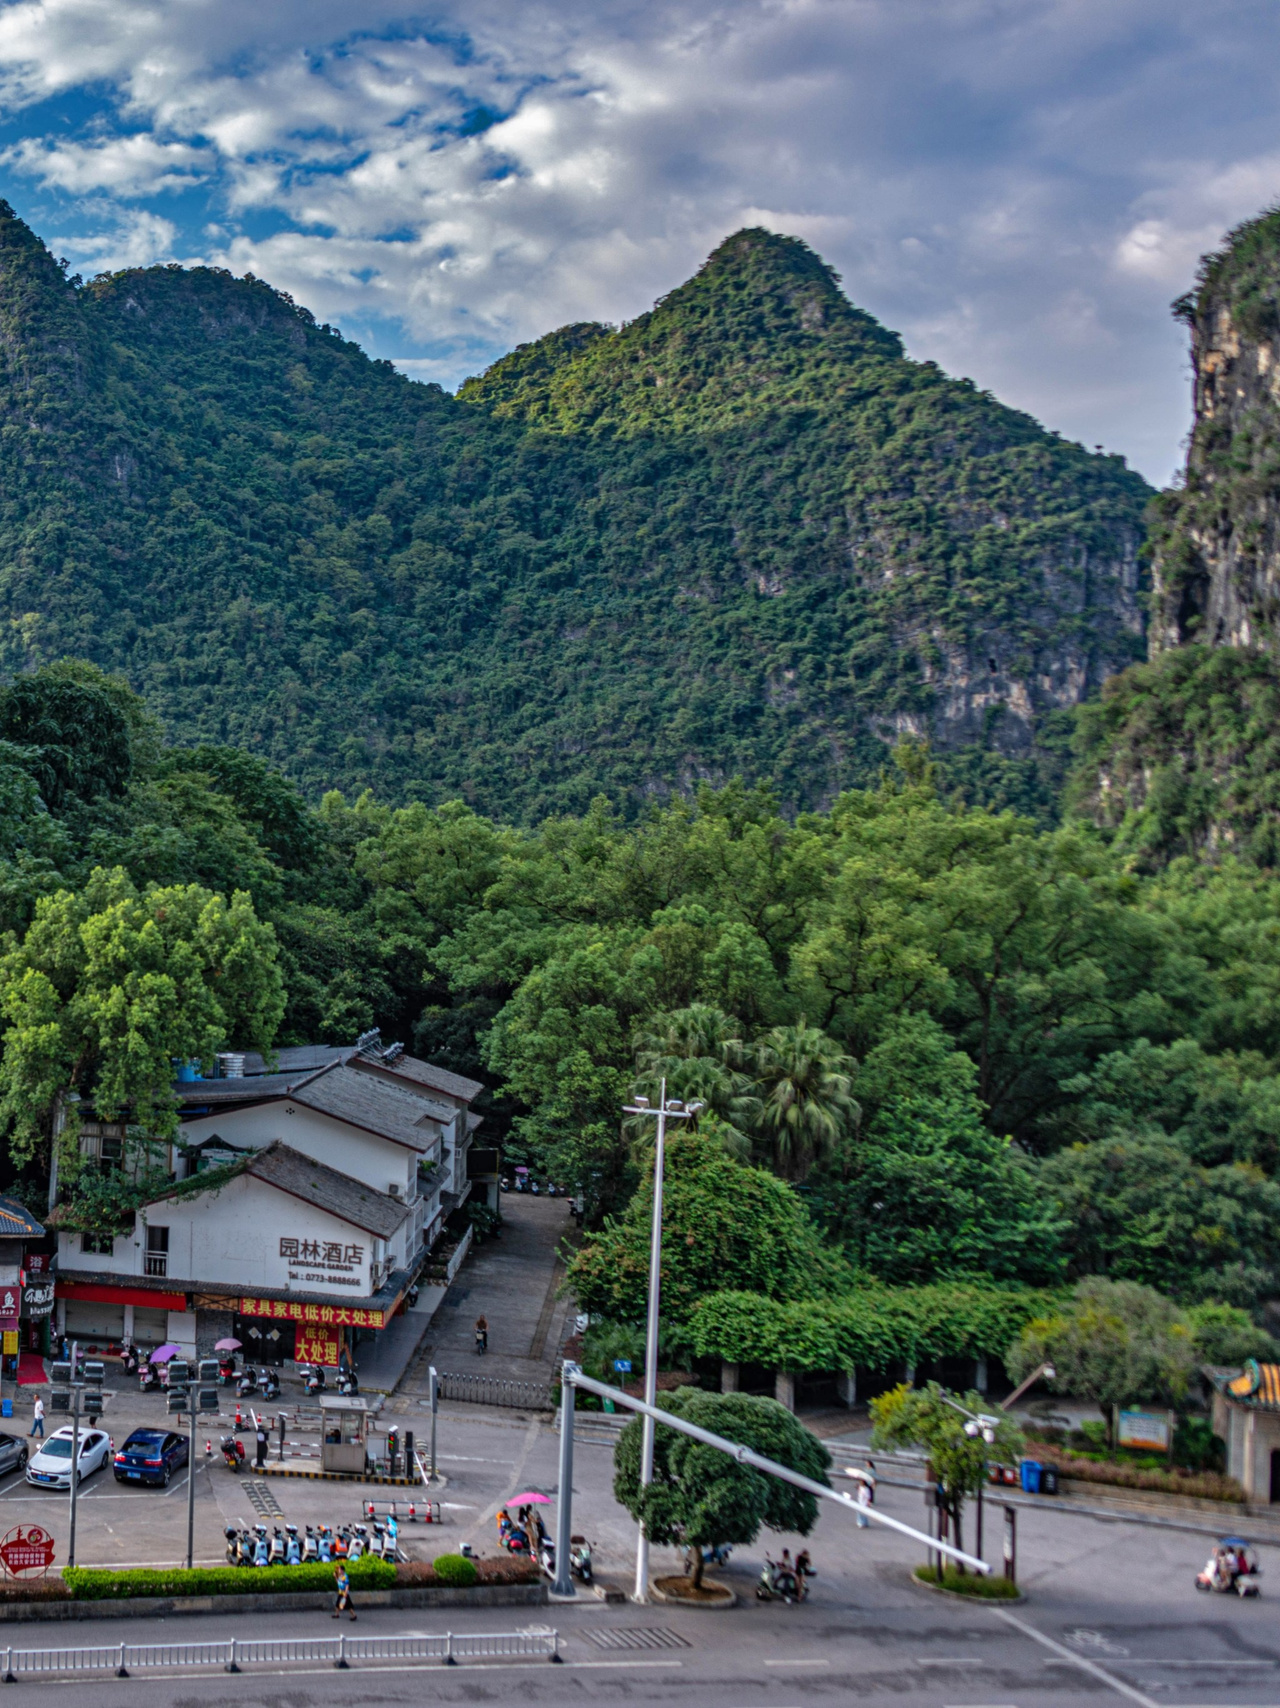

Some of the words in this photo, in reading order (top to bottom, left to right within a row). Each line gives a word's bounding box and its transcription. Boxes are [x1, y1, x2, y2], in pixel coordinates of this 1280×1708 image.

[280, 1237, 364, 1265] 园林酒店
[288, 1259, 326, 1269] LANDSCAPE
[327, 1263, 354, 1272] GARDEN
[243, 1298, 384, 1327] 家具家电低价大处理
[305, 1327, 330, 1341] 低价
[296, 1338, 338, 1365] 大处理
